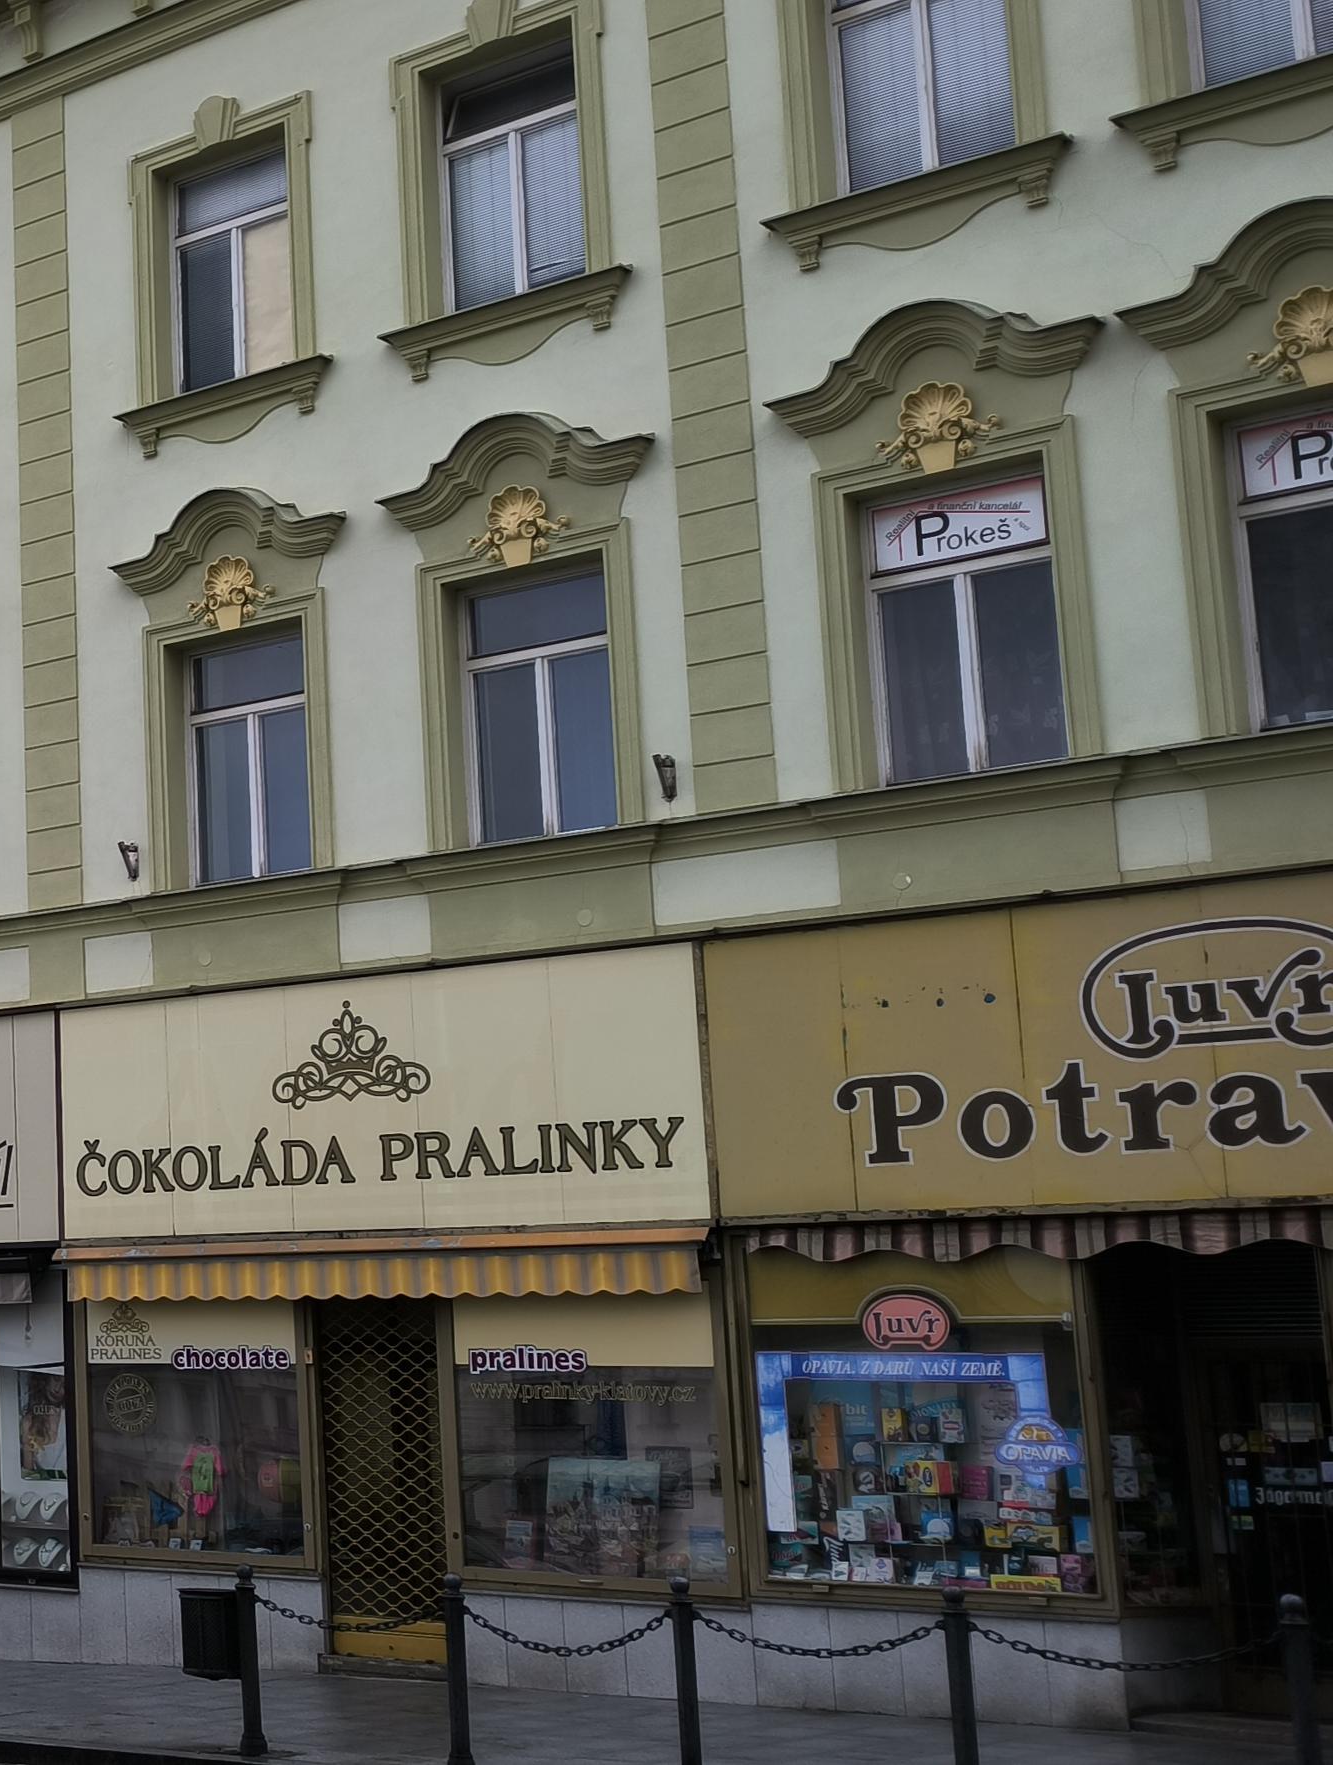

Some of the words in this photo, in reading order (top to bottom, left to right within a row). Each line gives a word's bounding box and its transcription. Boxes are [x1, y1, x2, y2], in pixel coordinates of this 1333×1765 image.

[1291, 430, 1333, 480] Pr
[885, 510, 915, 541] Realitní
[915, 512, 1012, 556] Prokeš
[76, 1128, 356, 1197] ČOKOLÁDA
[379, 1116, 685, 1181] PRALINKY
[871, 1310, 940, 1342] Juvr
[90, 1348, 162, 1360] PRALINES
[95, 1334, 156, 1347] KORUNA
[173, 1346, 291, 1370] chocolate
[469, 1345, 588, 1374] pralines
[802, 1359, 855, 1375] OPAVIA.
[860, 1360, 870, 1375] Z
[919, 1358, 957, 1376] NAŠÍ
[961, 1358, 1006, 1378] ZEMĚ.
[470, 1380, 697, 1406] www.pralinky-klatovy.cz
[1004, 1442, 1071, 1461] OPAVIA
